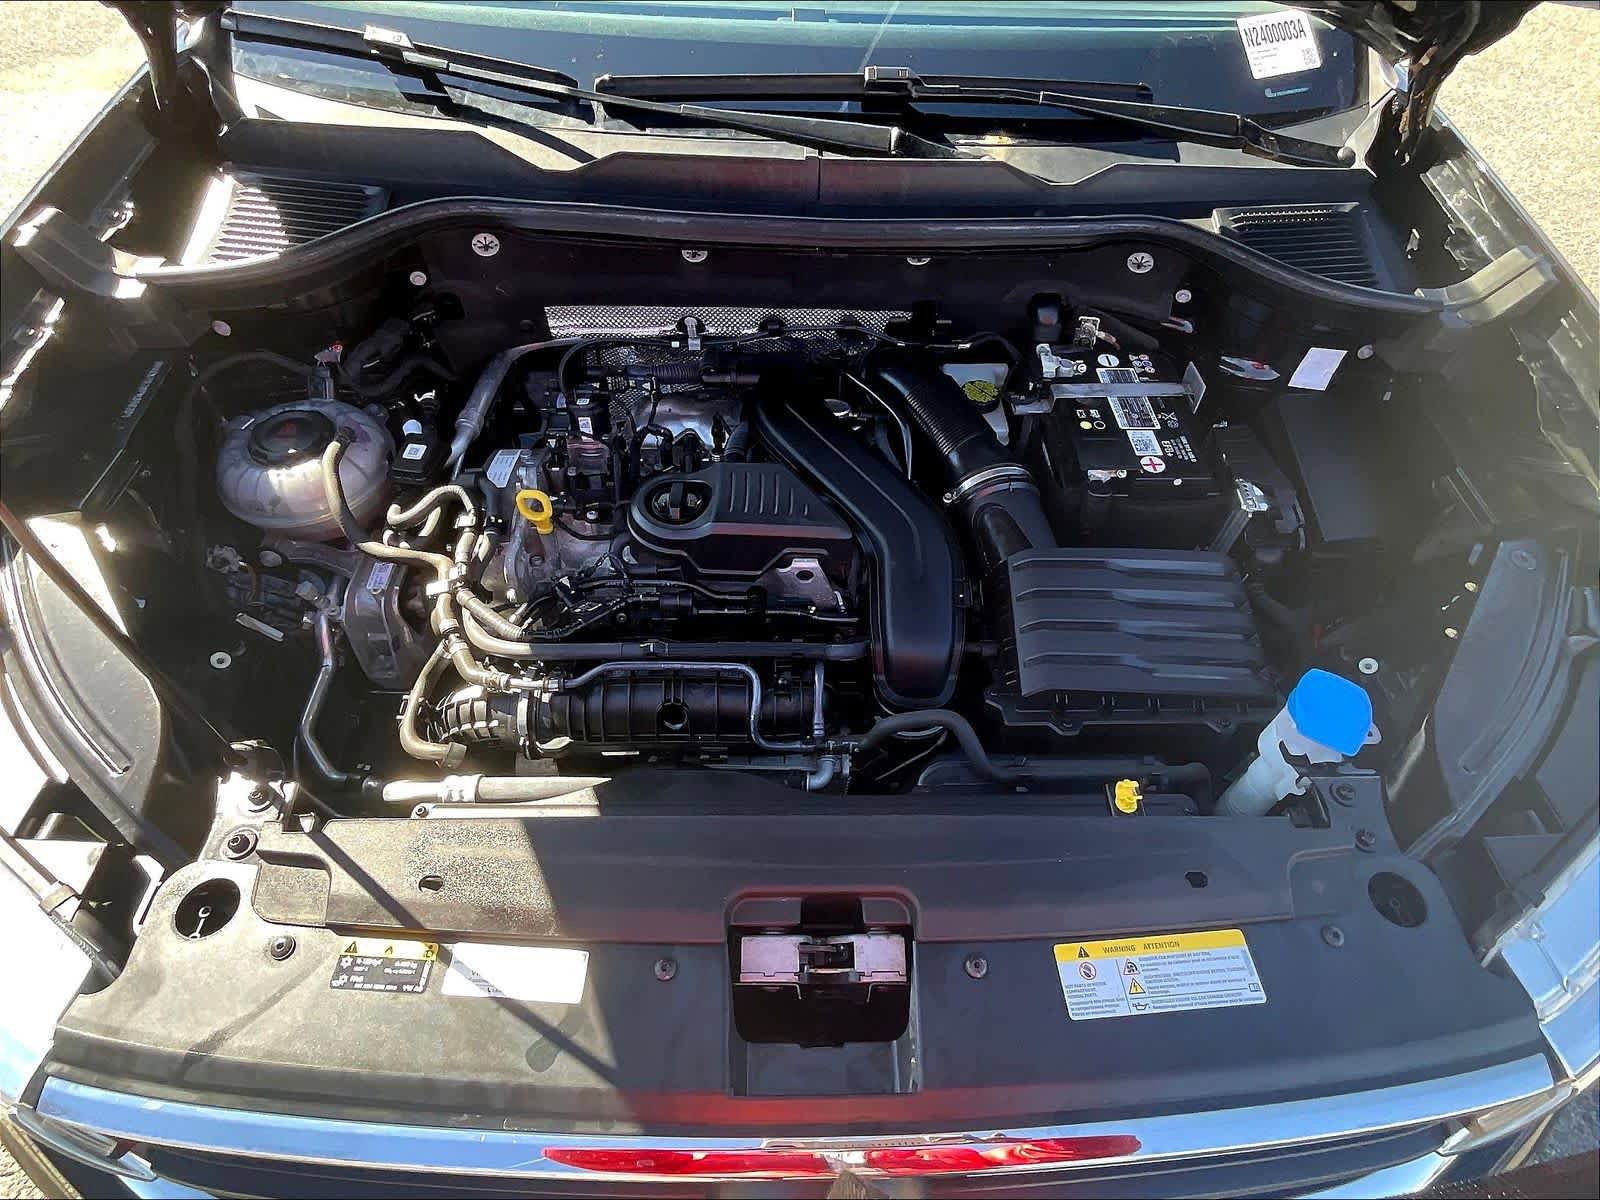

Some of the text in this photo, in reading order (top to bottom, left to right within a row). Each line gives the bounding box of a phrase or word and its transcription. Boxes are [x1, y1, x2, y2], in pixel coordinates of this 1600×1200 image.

[1243, 18, 1307, 48] N2400003A
[1102, 940, 1180, 954] WARNING ATTENTION
